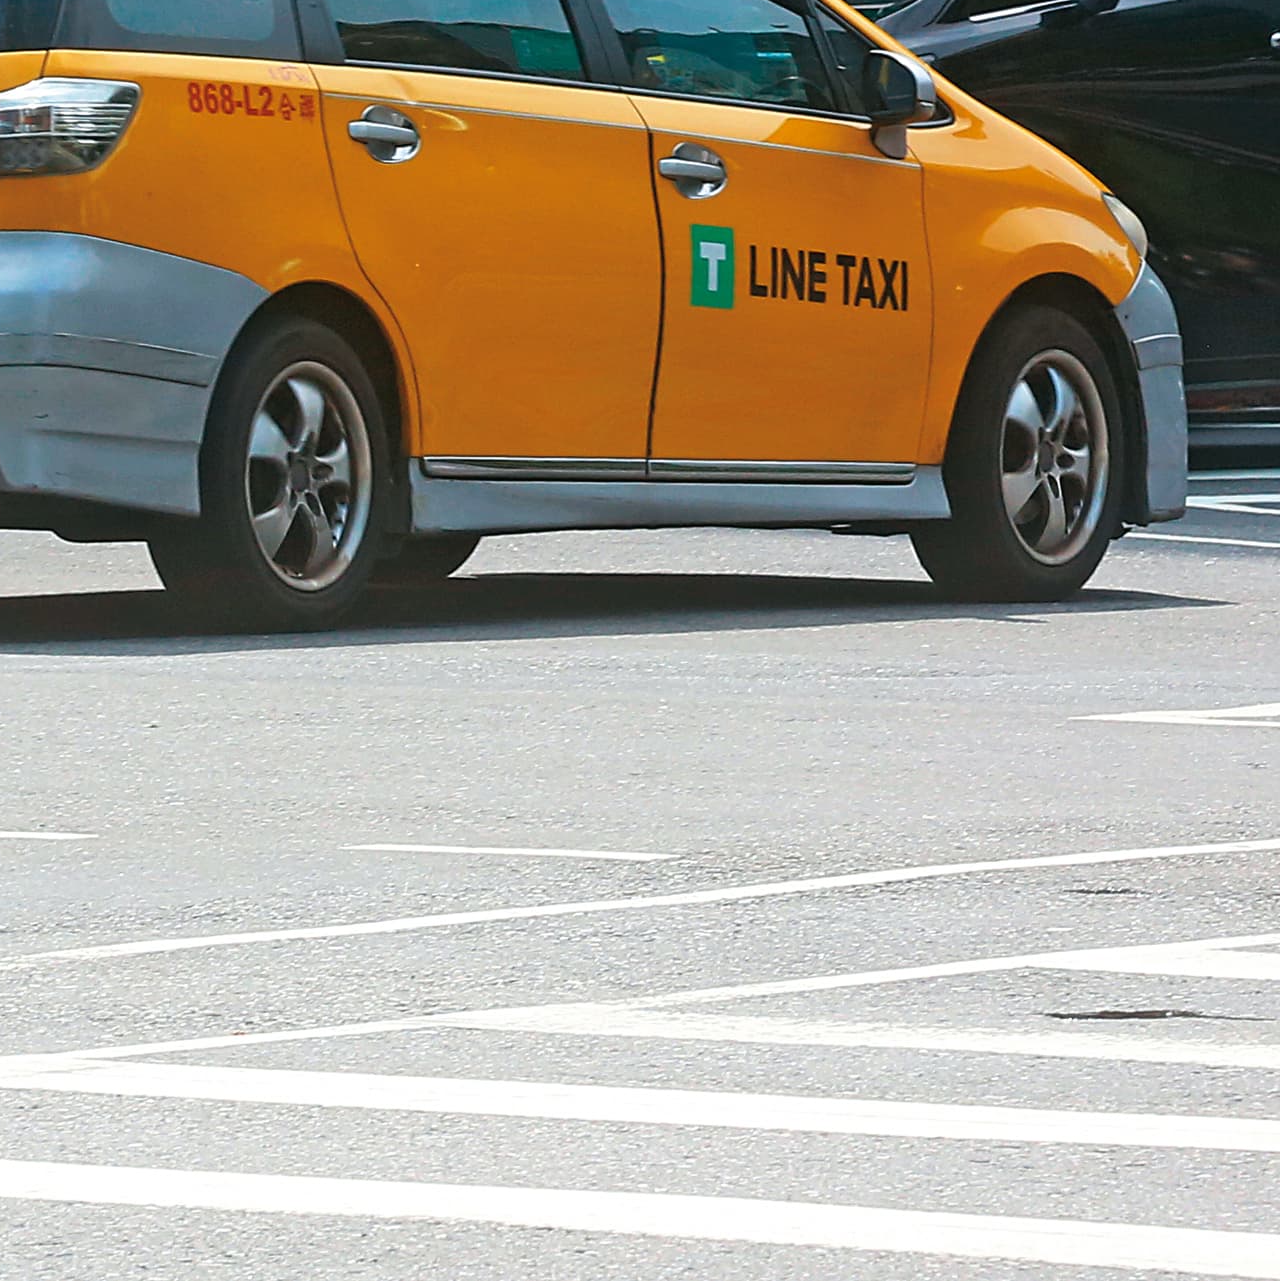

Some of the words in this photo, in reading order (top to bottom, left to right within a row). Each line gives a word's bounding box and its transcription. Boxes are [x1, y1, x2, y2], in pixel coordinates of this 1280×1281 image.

[187, 81, 275, 117] 868-L2
[749, 244, 827, 304] LINE
[836, 254, 909, 312] TAXI
